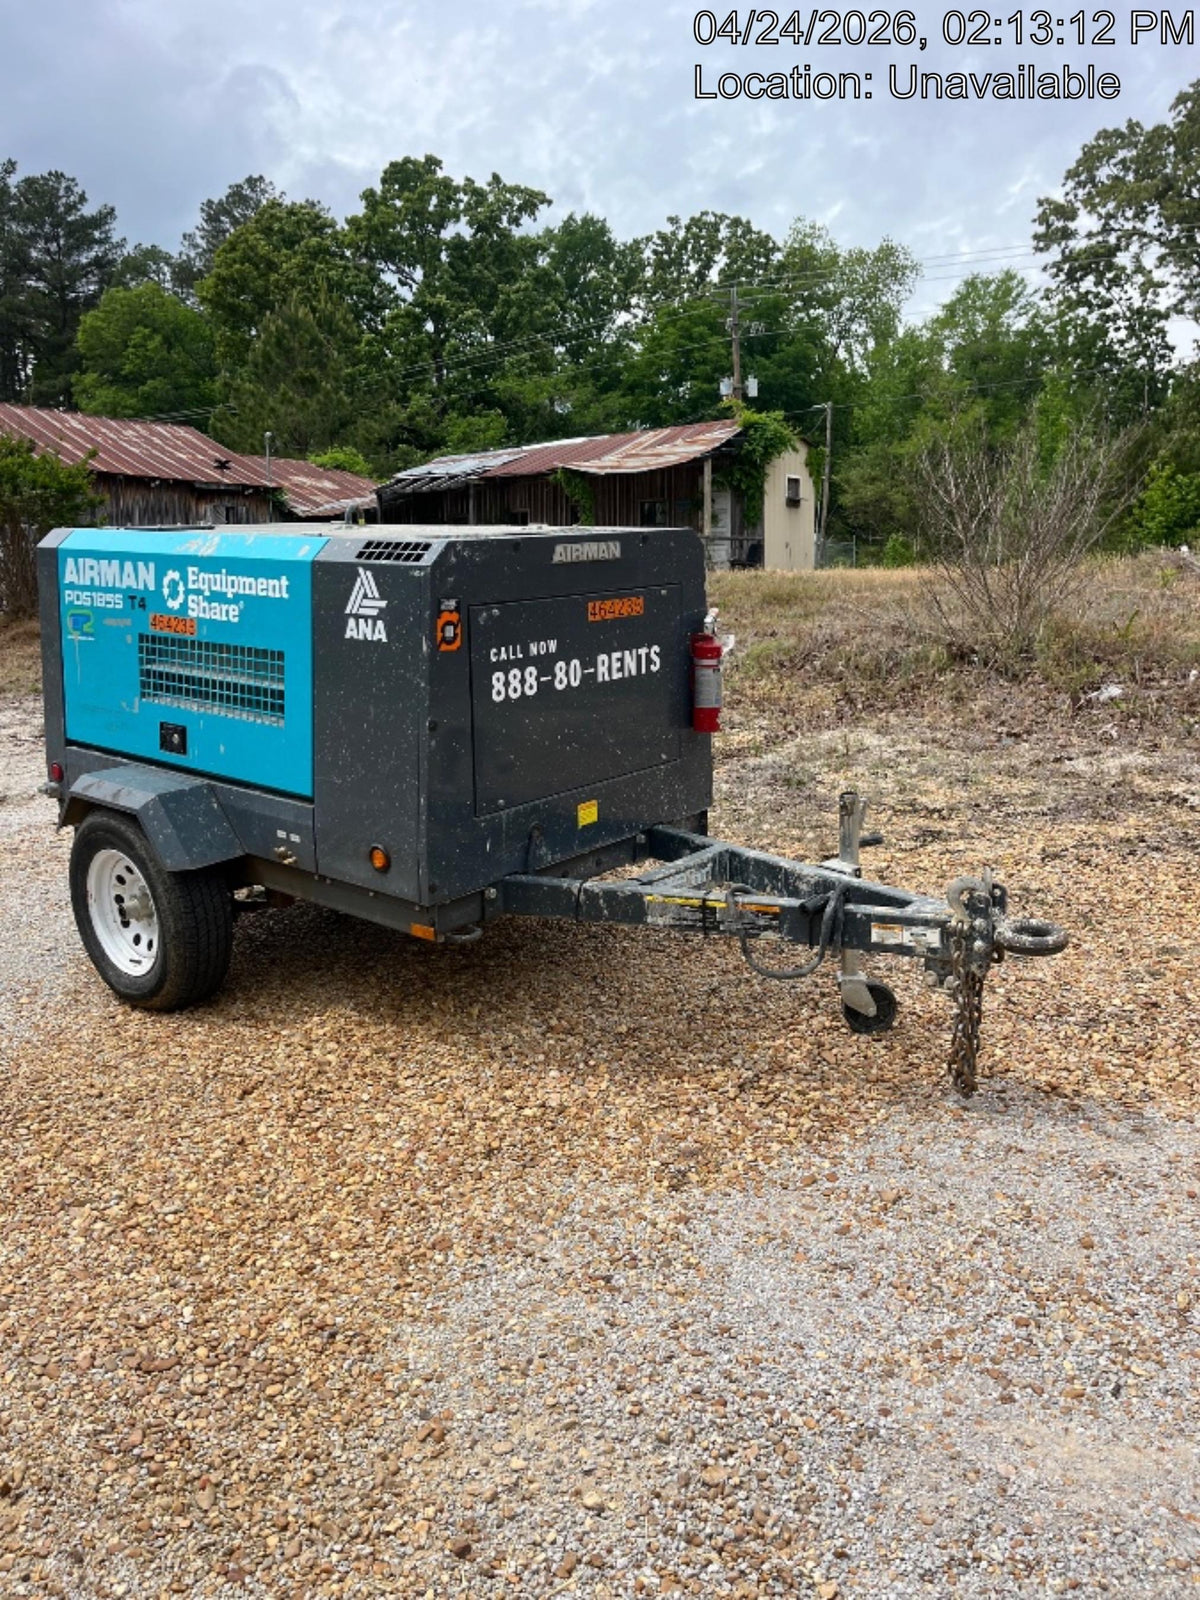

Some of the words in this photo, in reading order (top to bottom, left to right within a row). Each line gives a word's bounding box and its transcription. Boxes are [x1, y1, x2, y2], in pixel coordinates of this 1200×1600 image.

[551, 540, 622, 565] AIRMAN
[64, 557, 156, 591] AIRMAN
[187, 566, 290, 599] Equipment
[64, 589, 124, 609] PDS185S
[127, 595, 147, 612] T4
[344, 618, 388, 643] ANA
[489, 641, 524, 663] CALL
[529, 639, 558, 658] NOW
[491, 645, 661, 703] 888-80-RENTS
